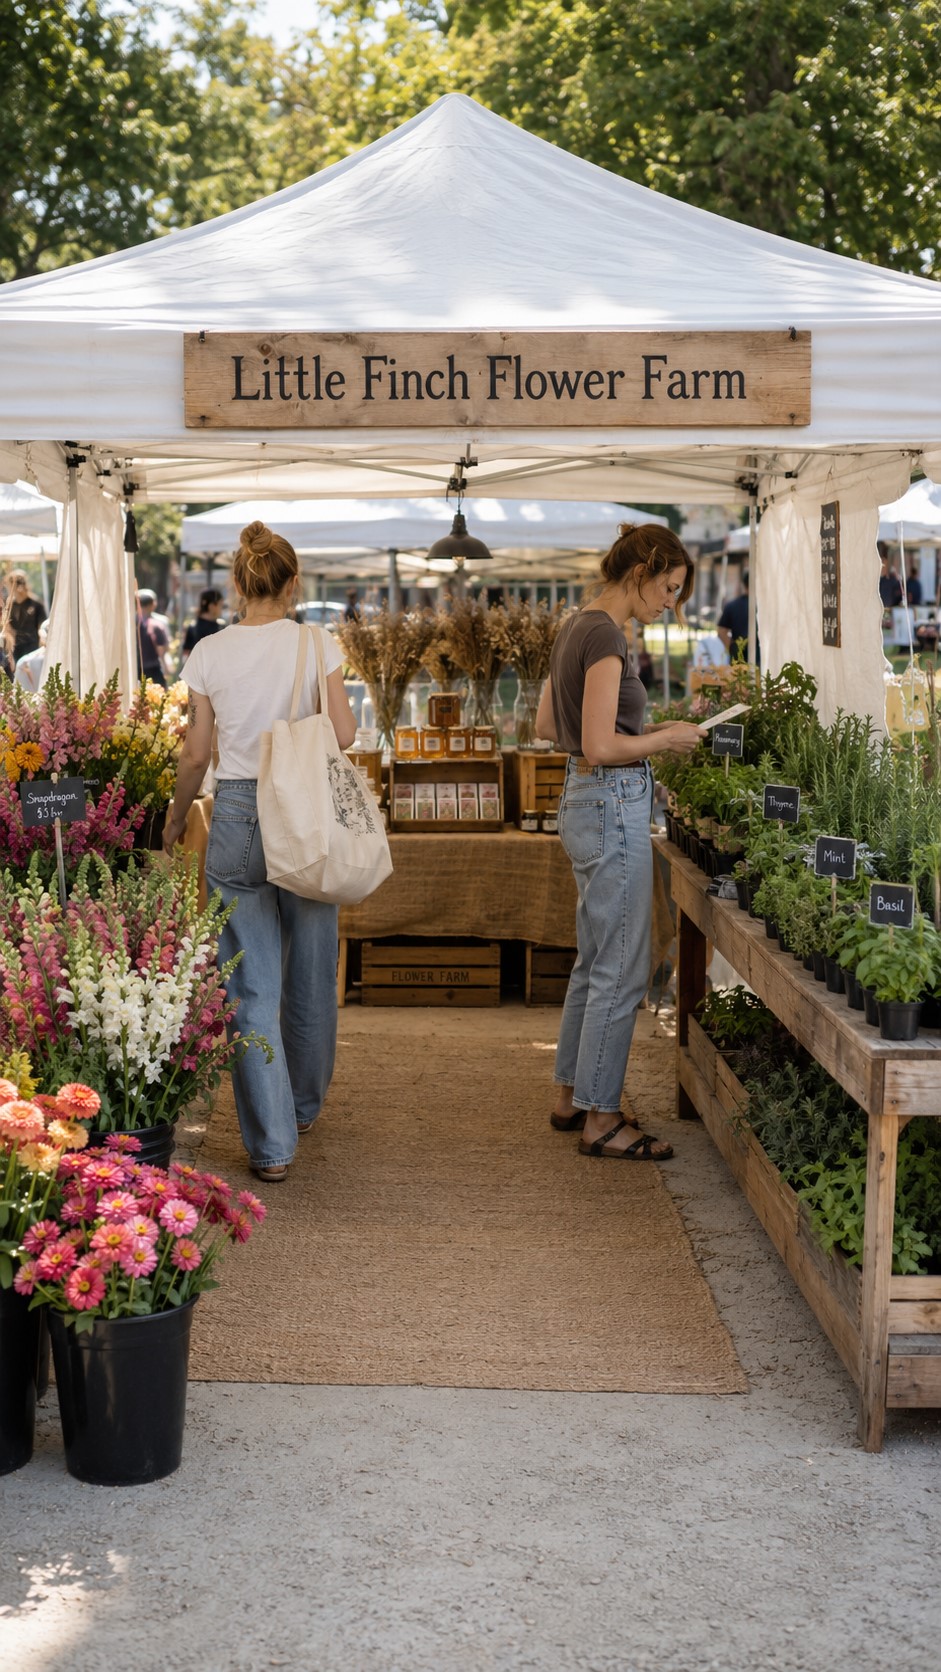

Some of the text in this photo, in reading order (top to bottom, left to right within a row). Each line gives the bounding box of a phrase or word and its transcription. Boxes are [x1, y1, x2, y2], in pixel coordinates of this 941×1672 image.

[231, 354, 747, 401] Little Finch Flower Farm
[767, 795, 795, 812] Thyme
[823, 850, 846, 864] Mint
[877, 895, 905, 912] Basil
[391, 970, 470, 983] FLOWER FARM
